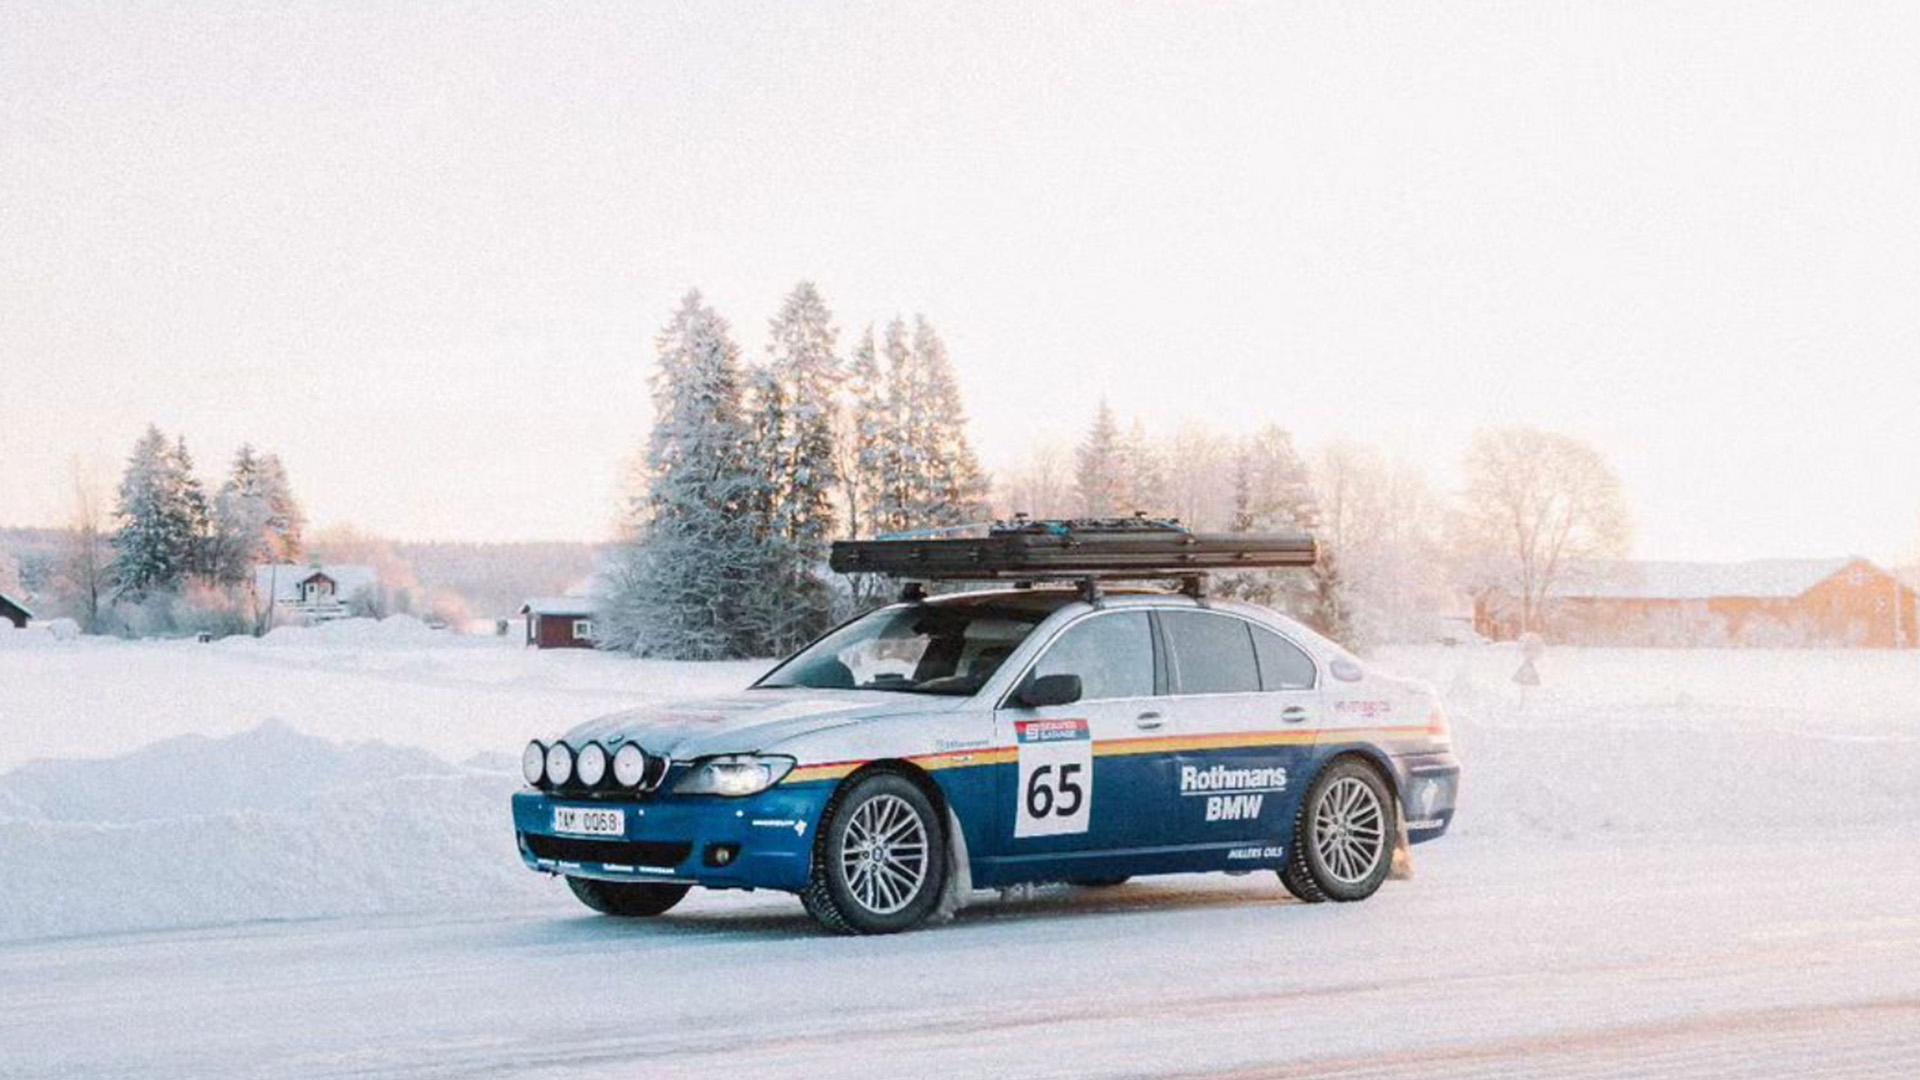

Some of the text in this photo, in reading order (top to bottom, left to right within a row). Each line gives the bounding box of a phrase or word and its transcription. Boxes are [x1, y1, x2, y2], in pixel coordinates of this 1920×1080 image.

[1181, 765, 1287, 791] Rothmans
[1027, 764, 1082, 819] 65
[1205, 795, 1263, 821] BMW
